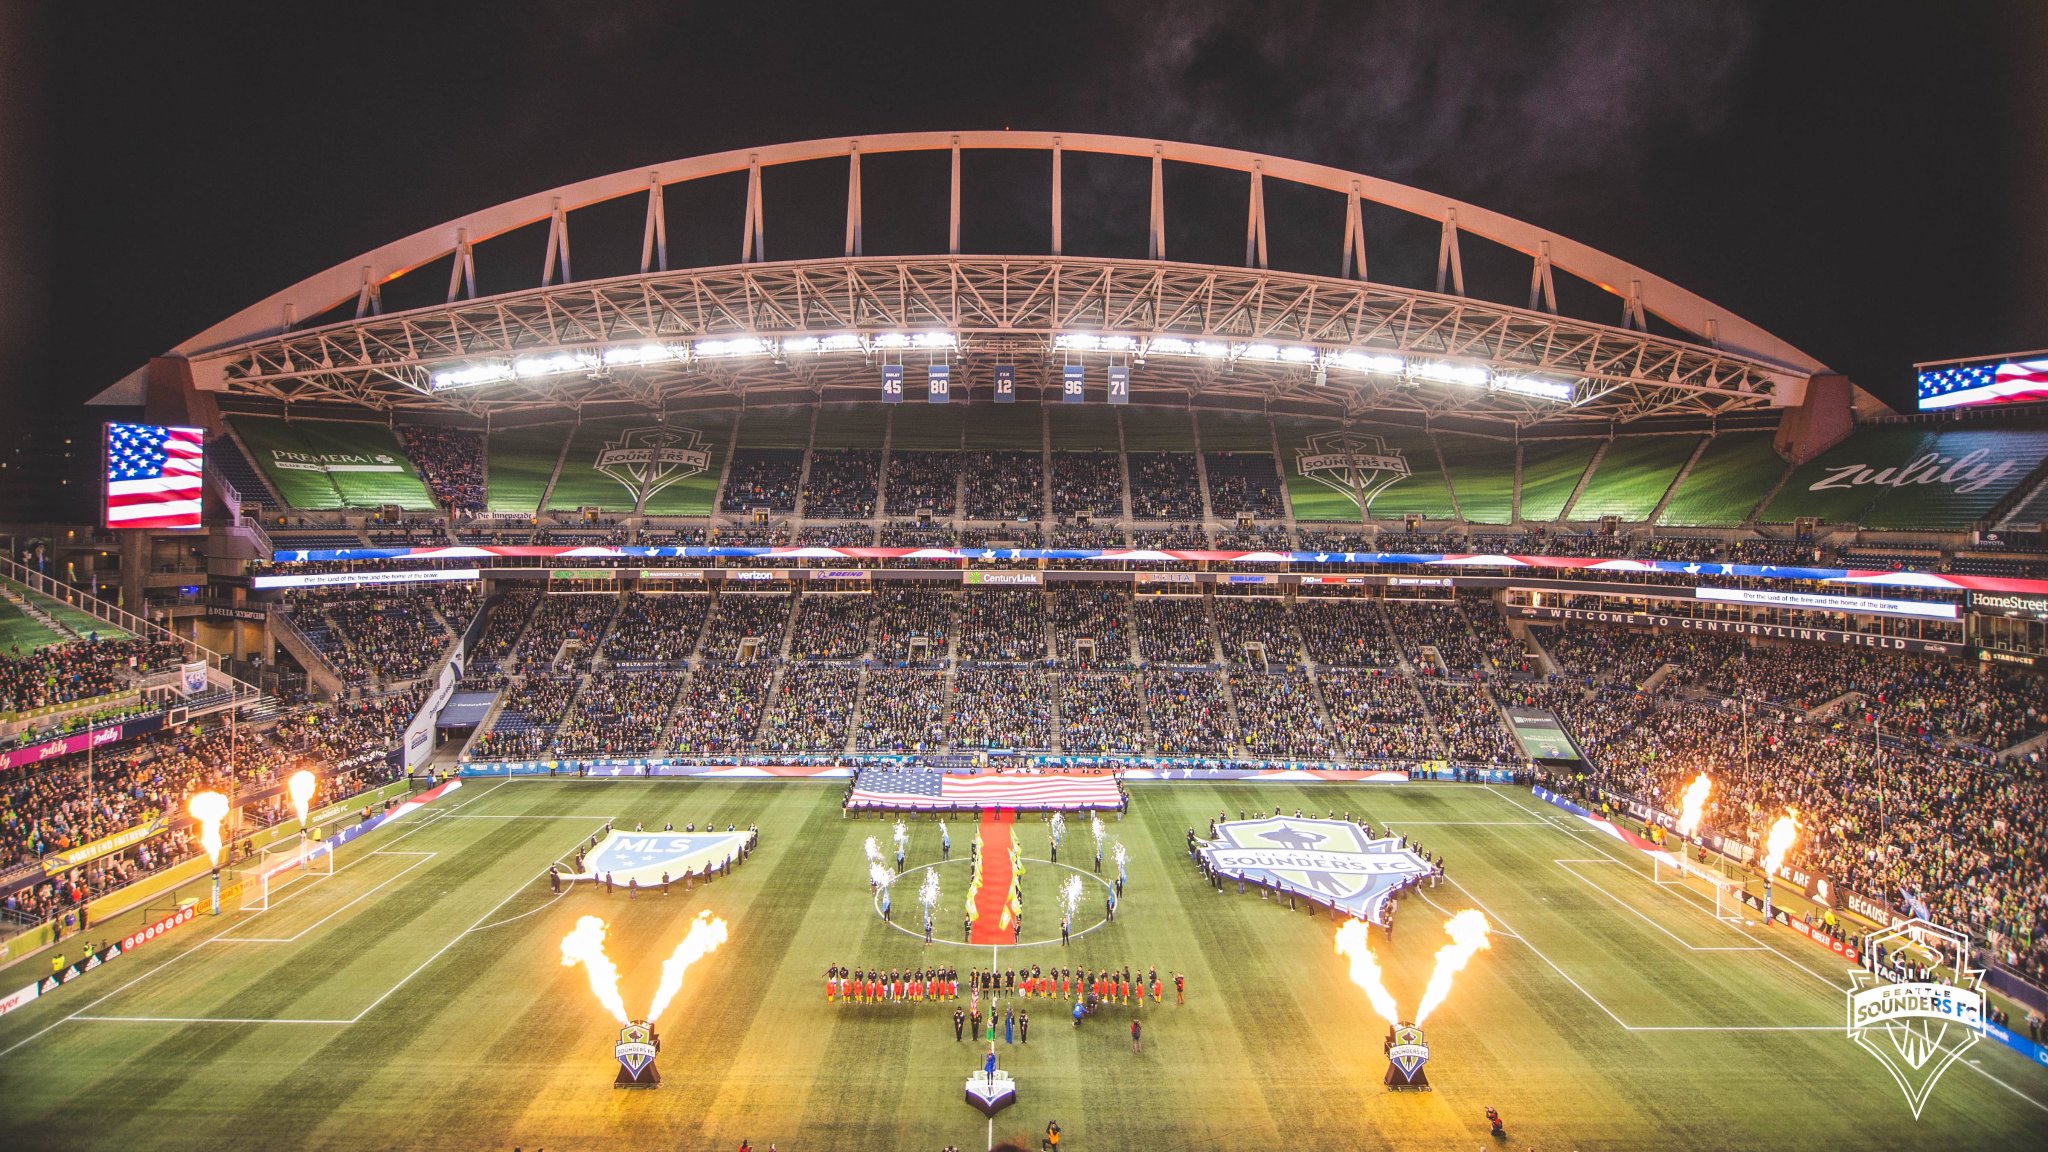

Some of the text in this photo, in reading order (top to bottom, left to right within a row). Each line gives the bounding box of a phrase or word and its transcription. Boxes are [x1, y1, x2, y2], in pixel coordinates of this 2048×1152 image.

[883, 379, 902, 394] 45
[930, 379, 948, 394] 80
[997, 379, 1012, 394] 12
[1064, 380, 1083, 395] 96
[1110, 381, 1126, 395] 71
[271, 450, 368, 464] PREMERA
[686, 455, 703, 464] FC
[1383, 461, 1401, 470] FC
[1808, 448, 2017, 493] zulily
[737, 571, 773, 580] verizon
[983, 574, 1037, 584] CenturyLink
[1879, 602, 1899, 610] brave
[1972, 592, 2048, 612] HomeStreet
[214, 607, 234, 617] DELTA
[1550, 609, 1907, 649] WELCOME TO CENTURYLINK FIELD
[1992, 653, 2035, 665] STARBUCKS
[93, 727, 119, 746] zulily
[40, 740, 68, 760] zulily
[1657, 812, 1674, 829] FC
[69, 828, 149, 864] NORTH END FAITHFUL
[614, 838, 692, 853] MLS
[1222, 856, 1412, 871] SOUNDERS FC
[1848, 895, 1889, 926] BECAUSE
